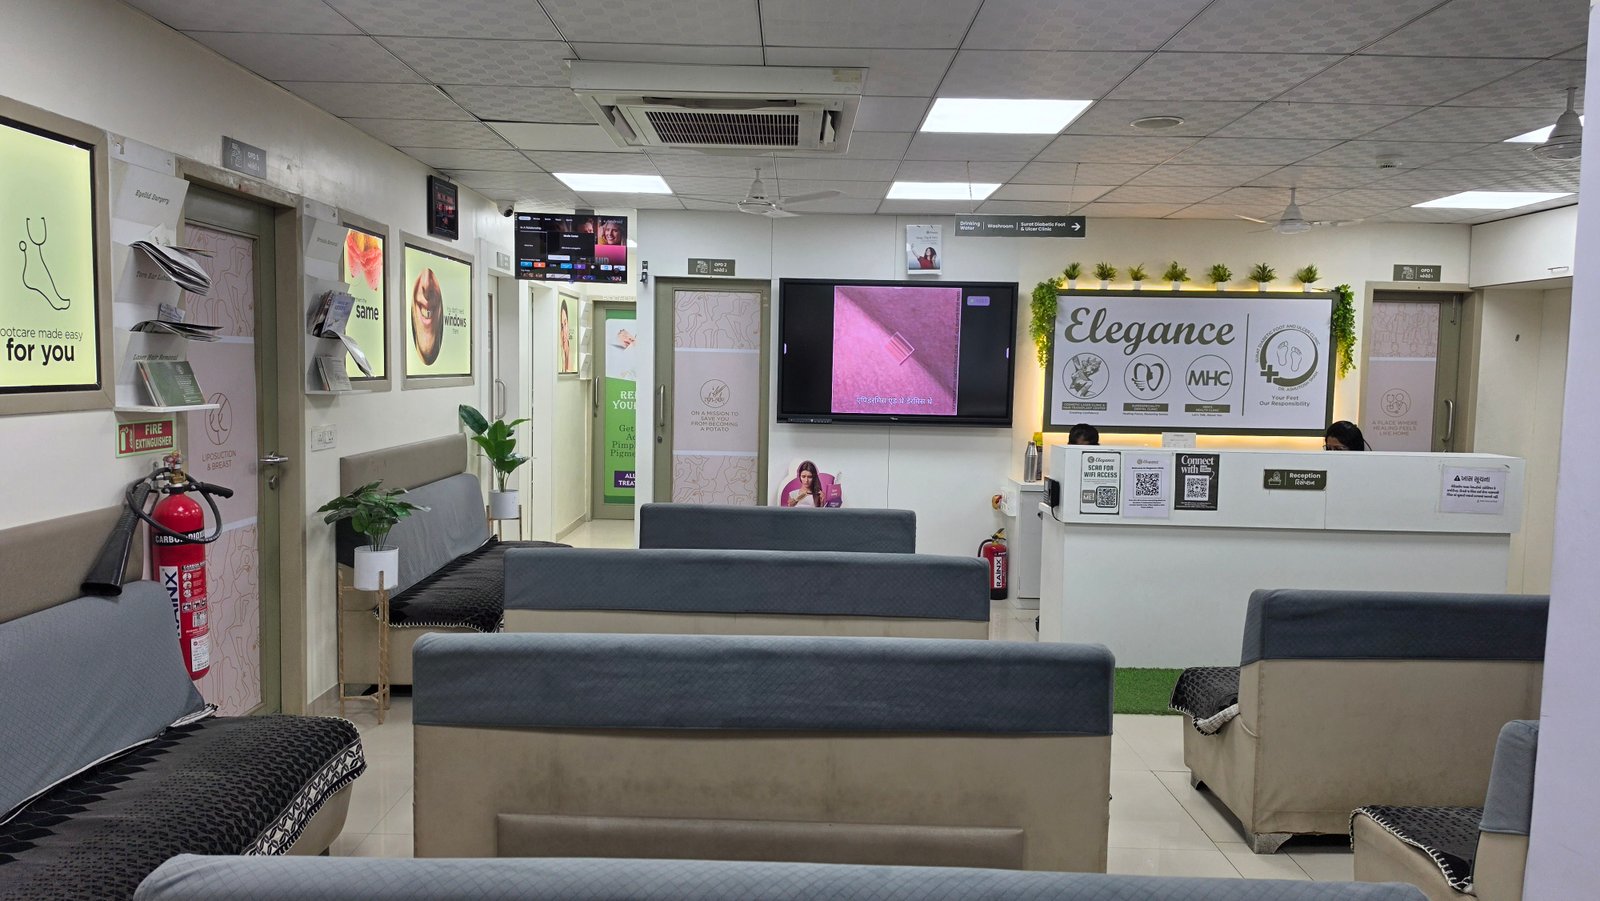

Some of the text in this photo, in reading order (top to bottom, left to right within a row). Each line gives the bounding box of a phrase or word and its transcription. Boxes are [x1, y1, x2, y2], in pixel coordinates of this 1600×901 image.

[135, 189, 152, 200] Eyelid
[356, 304, 379, 320] same
[444, 312, 467, 328] windows
[0, 328, 83, 341] ootcare made easy
[1064, 306, 1236, 356] Elegance
[6, 337, 75, 366] for you
[1187, 370, 1231, 387] MHC
[145, 423, 163, 436] FIRE
[619, 424, 634, 432] Get
[135, 436, 172, 450] EXTINGUISHER
[202, 450, 237, 462] LIPOSUCTION
[1181, 455, 1215, 467] Connect
[212, 460, 233, 470] BREAST
[1181, 464, 1199, 474] with
